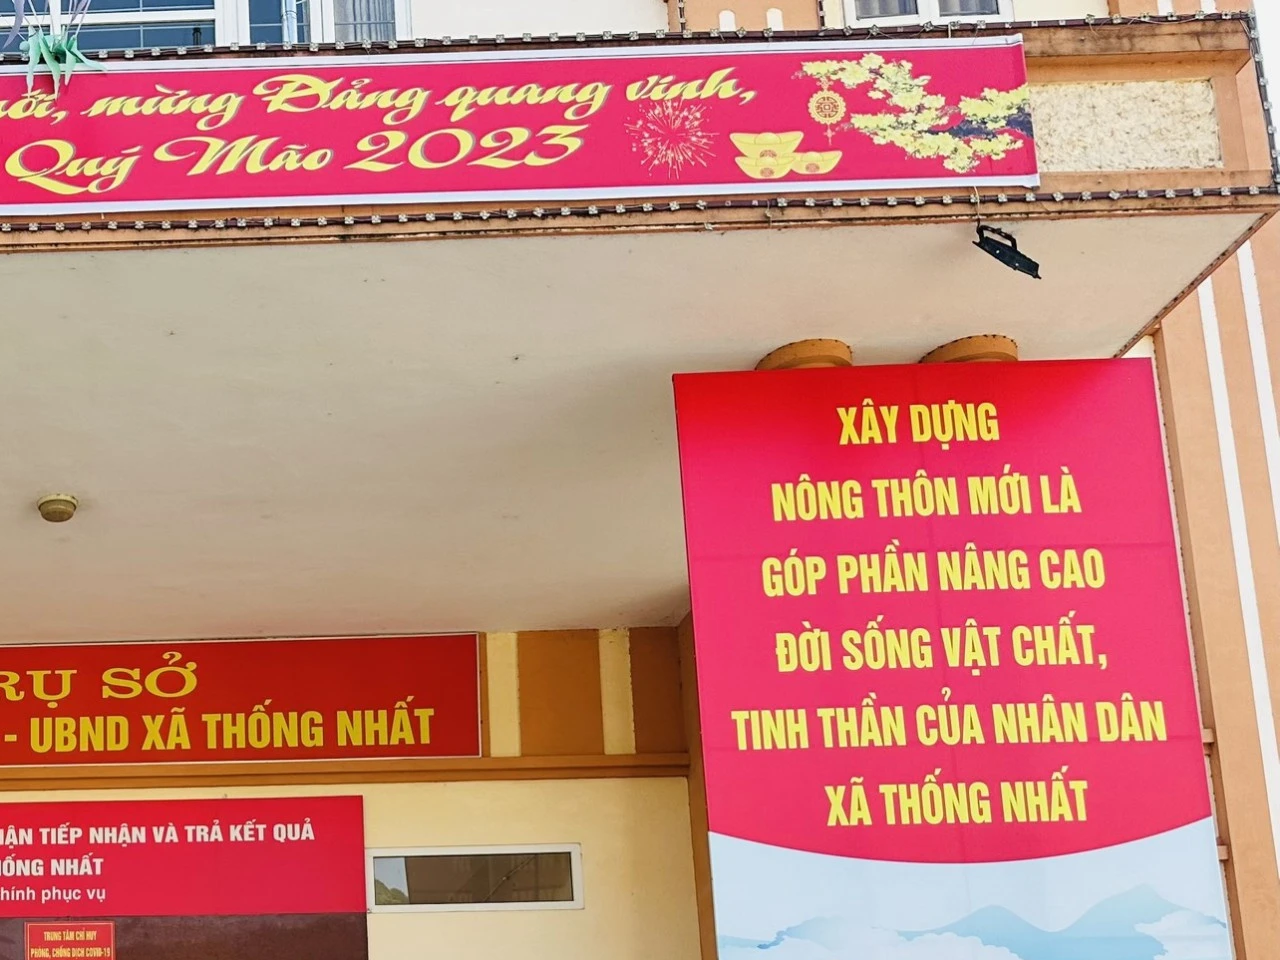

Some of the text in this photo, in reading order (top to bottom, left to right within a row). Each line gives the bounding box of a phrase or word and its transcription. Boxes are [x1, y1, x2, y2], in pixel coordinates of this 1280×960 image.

[82, 82, 244, 131] mừng
[254, 72, 431, 125] Đảng
[436, 77, 611, 129] quang
[620, 67, 759, 104] vinh,
[4, 138, 137, 195] Quý
[154, 135, 334, 176] Mão
[345, 123, 588, 174] 2023
[837, 398, 999, 450] XÂY DỰNG
[772, 464, 1081, 521] NÔNG THÔN MỚI LÀ
[762, 540, 1105, 597] GÓP PHẦN NÂNG CAO
[775, 611, 1107, 676] ĐỜI SỐNG VẬT CHẤT,
[102, 652, 197, 699] SỞ
[30, 715, 129, 753] UBND
[142, 707, 191, 751] XÃ
[201, 704, 324, 749] THỐNG
[336, 701, 435, 746] NHẤT
[731, 687, 1167, 750] TINH THẦN CỦA NHÂN DÂN
[825, 766, 1088, 827] XÃ THỐNG NHẤT
[39, 822, 83, 845] TIẾP
[89, 823, 146, 847] NHẬN
[152, 823, 179, 843] VÀ
[184, 819, 224, 842] TRẢ
[229, 819, 267, 842] KẾT
[273, 817, 315, 843] QUẢ
[50, 852, 104, 876] NHẤT
[41, 886, 81, 904] phục
[86, 889, 106, 903] vụ
